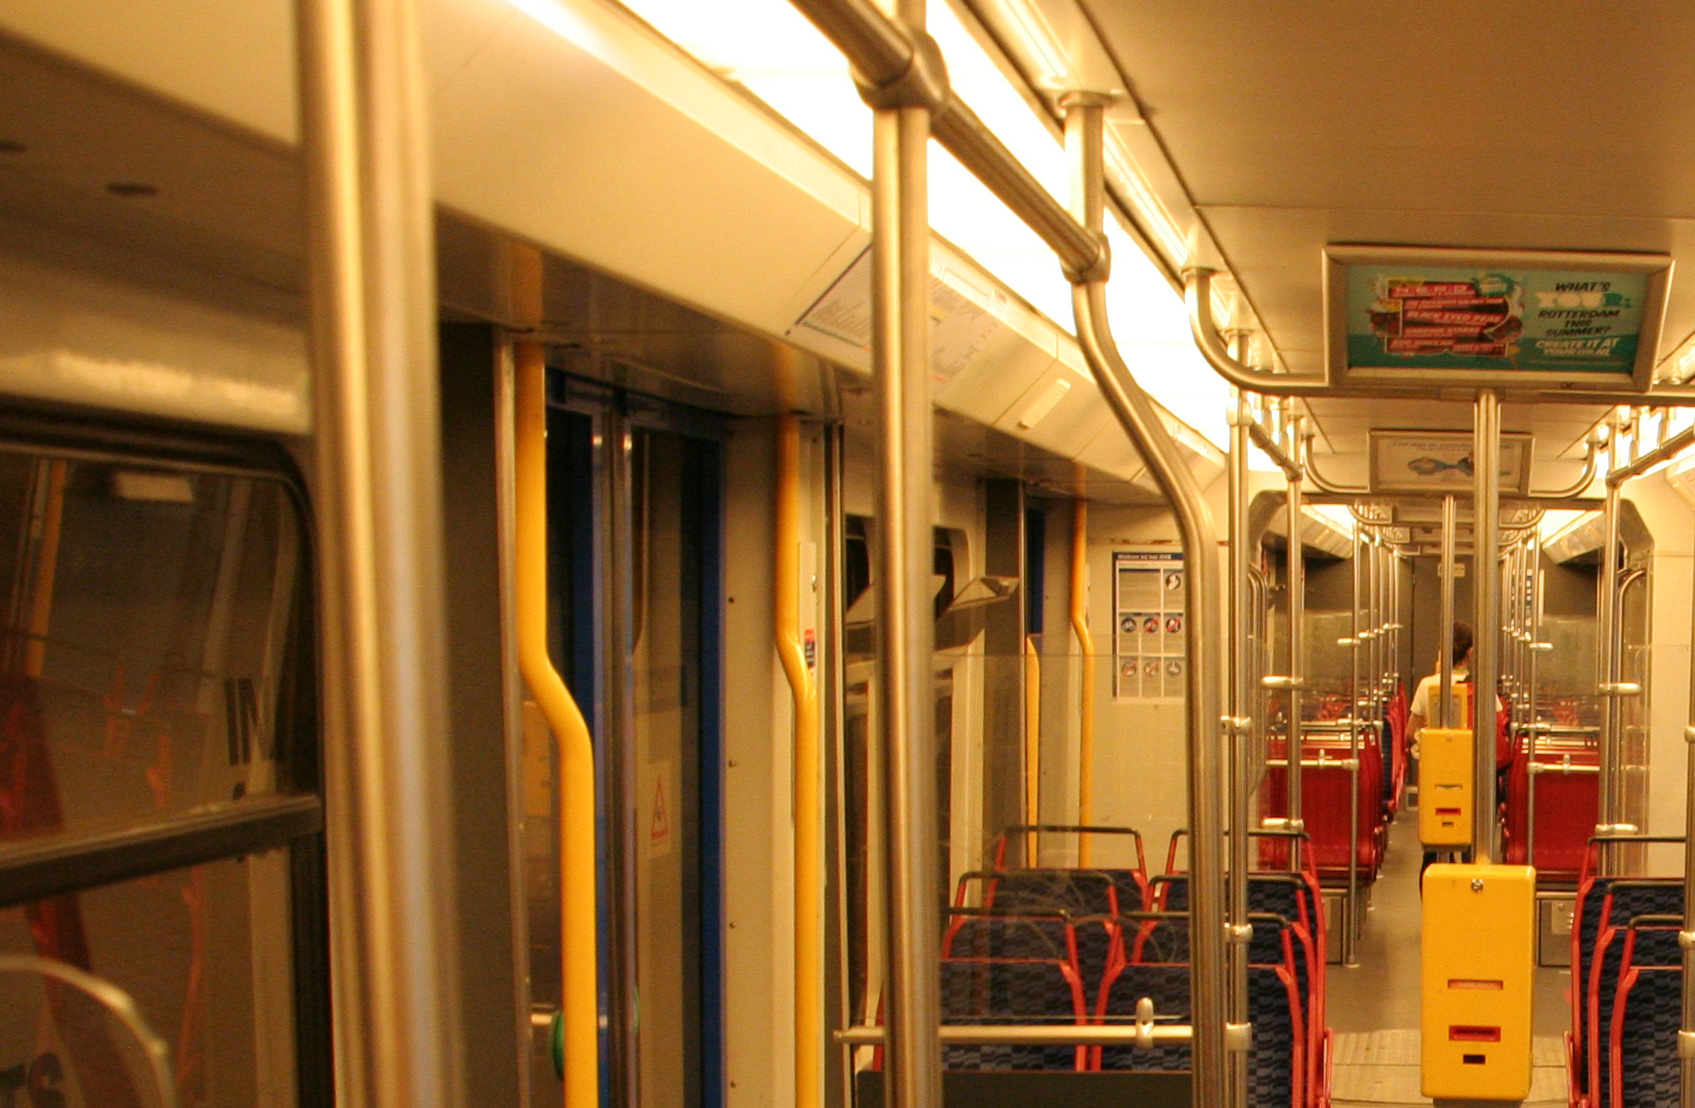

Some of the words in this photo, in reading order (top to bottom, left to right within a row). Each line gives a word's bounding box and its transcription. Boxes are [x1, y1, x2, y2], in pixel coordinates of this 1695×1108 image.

[1555, 281, 1612, 292] WHAT'S
[1538, 309, 1620, 319] ROTTERDAM
[1564, 319, 1594, 329] THIS
[1545, 325, 1612, 337] SUMMER?
